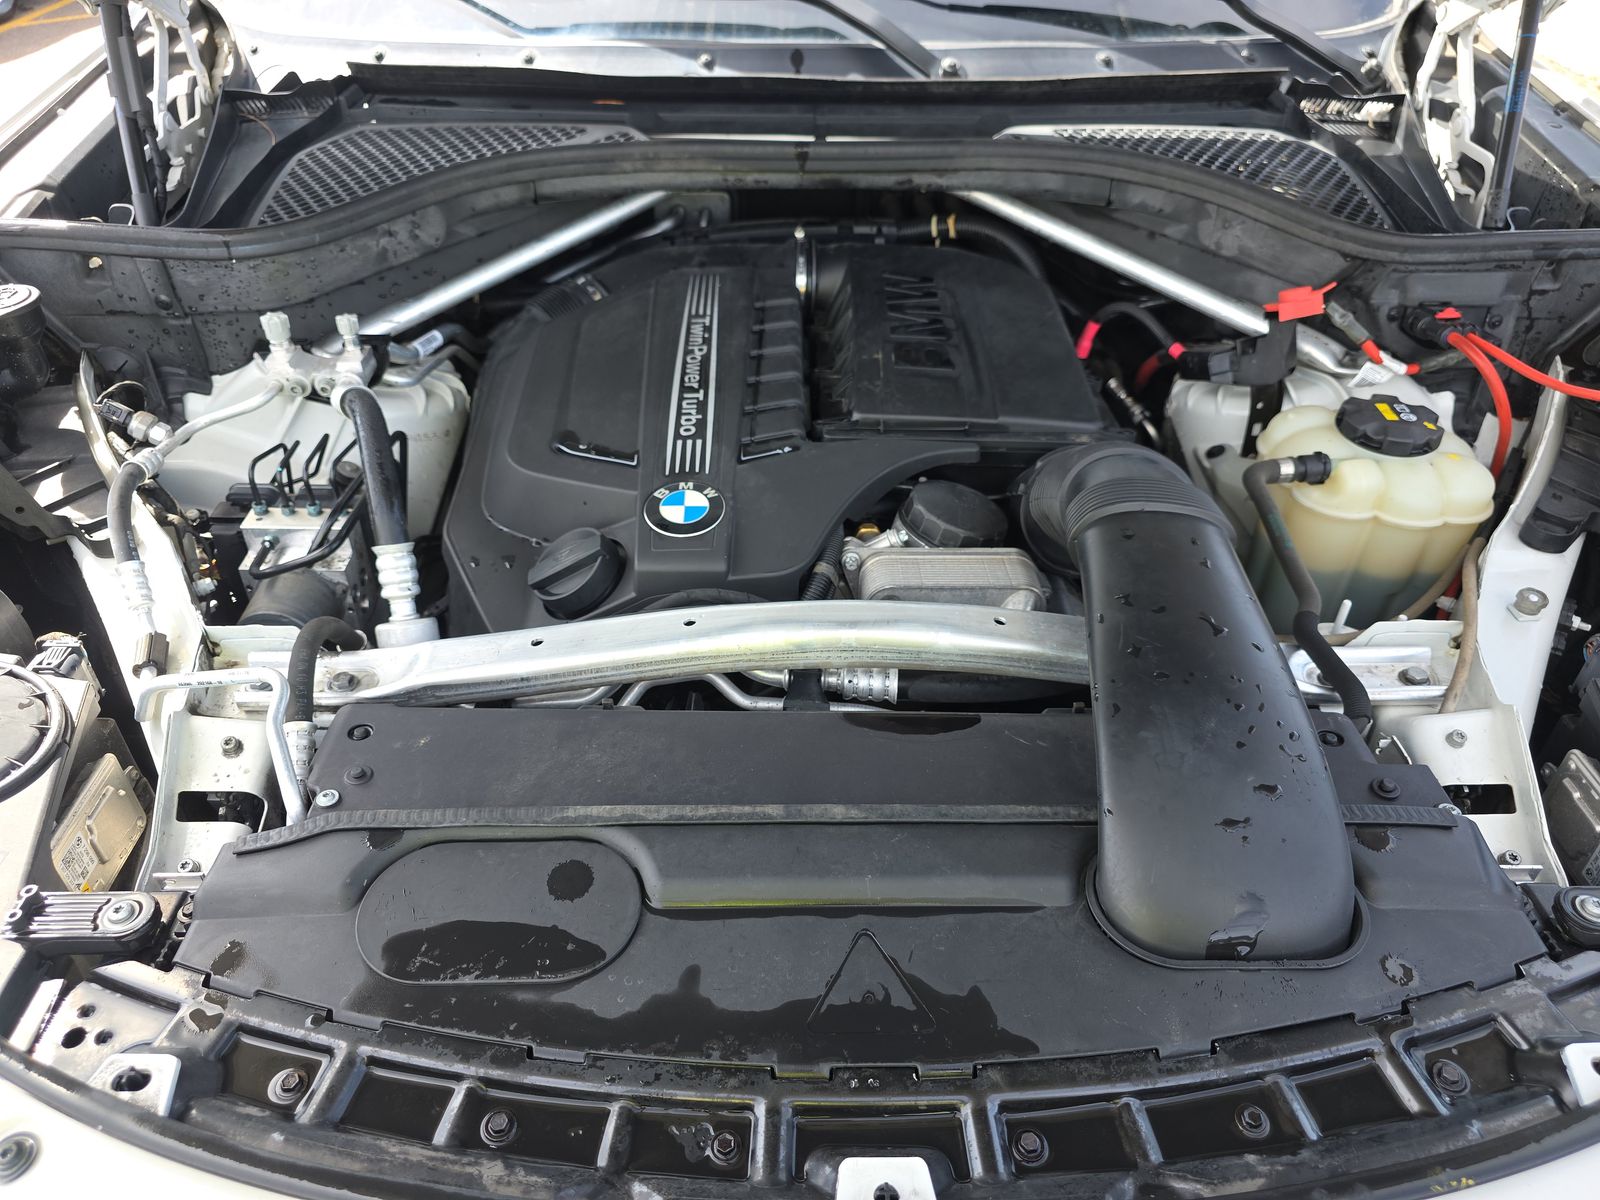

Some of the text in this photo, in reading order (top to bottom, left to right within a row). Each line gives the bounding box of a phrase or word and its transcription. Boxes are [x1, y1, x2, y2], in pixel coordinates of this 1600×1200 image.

[881, 272, 956, 371] BMW
[679, 315, 711, 437] TwinPower Turbo
[653, 481, 719, 500] BMW
